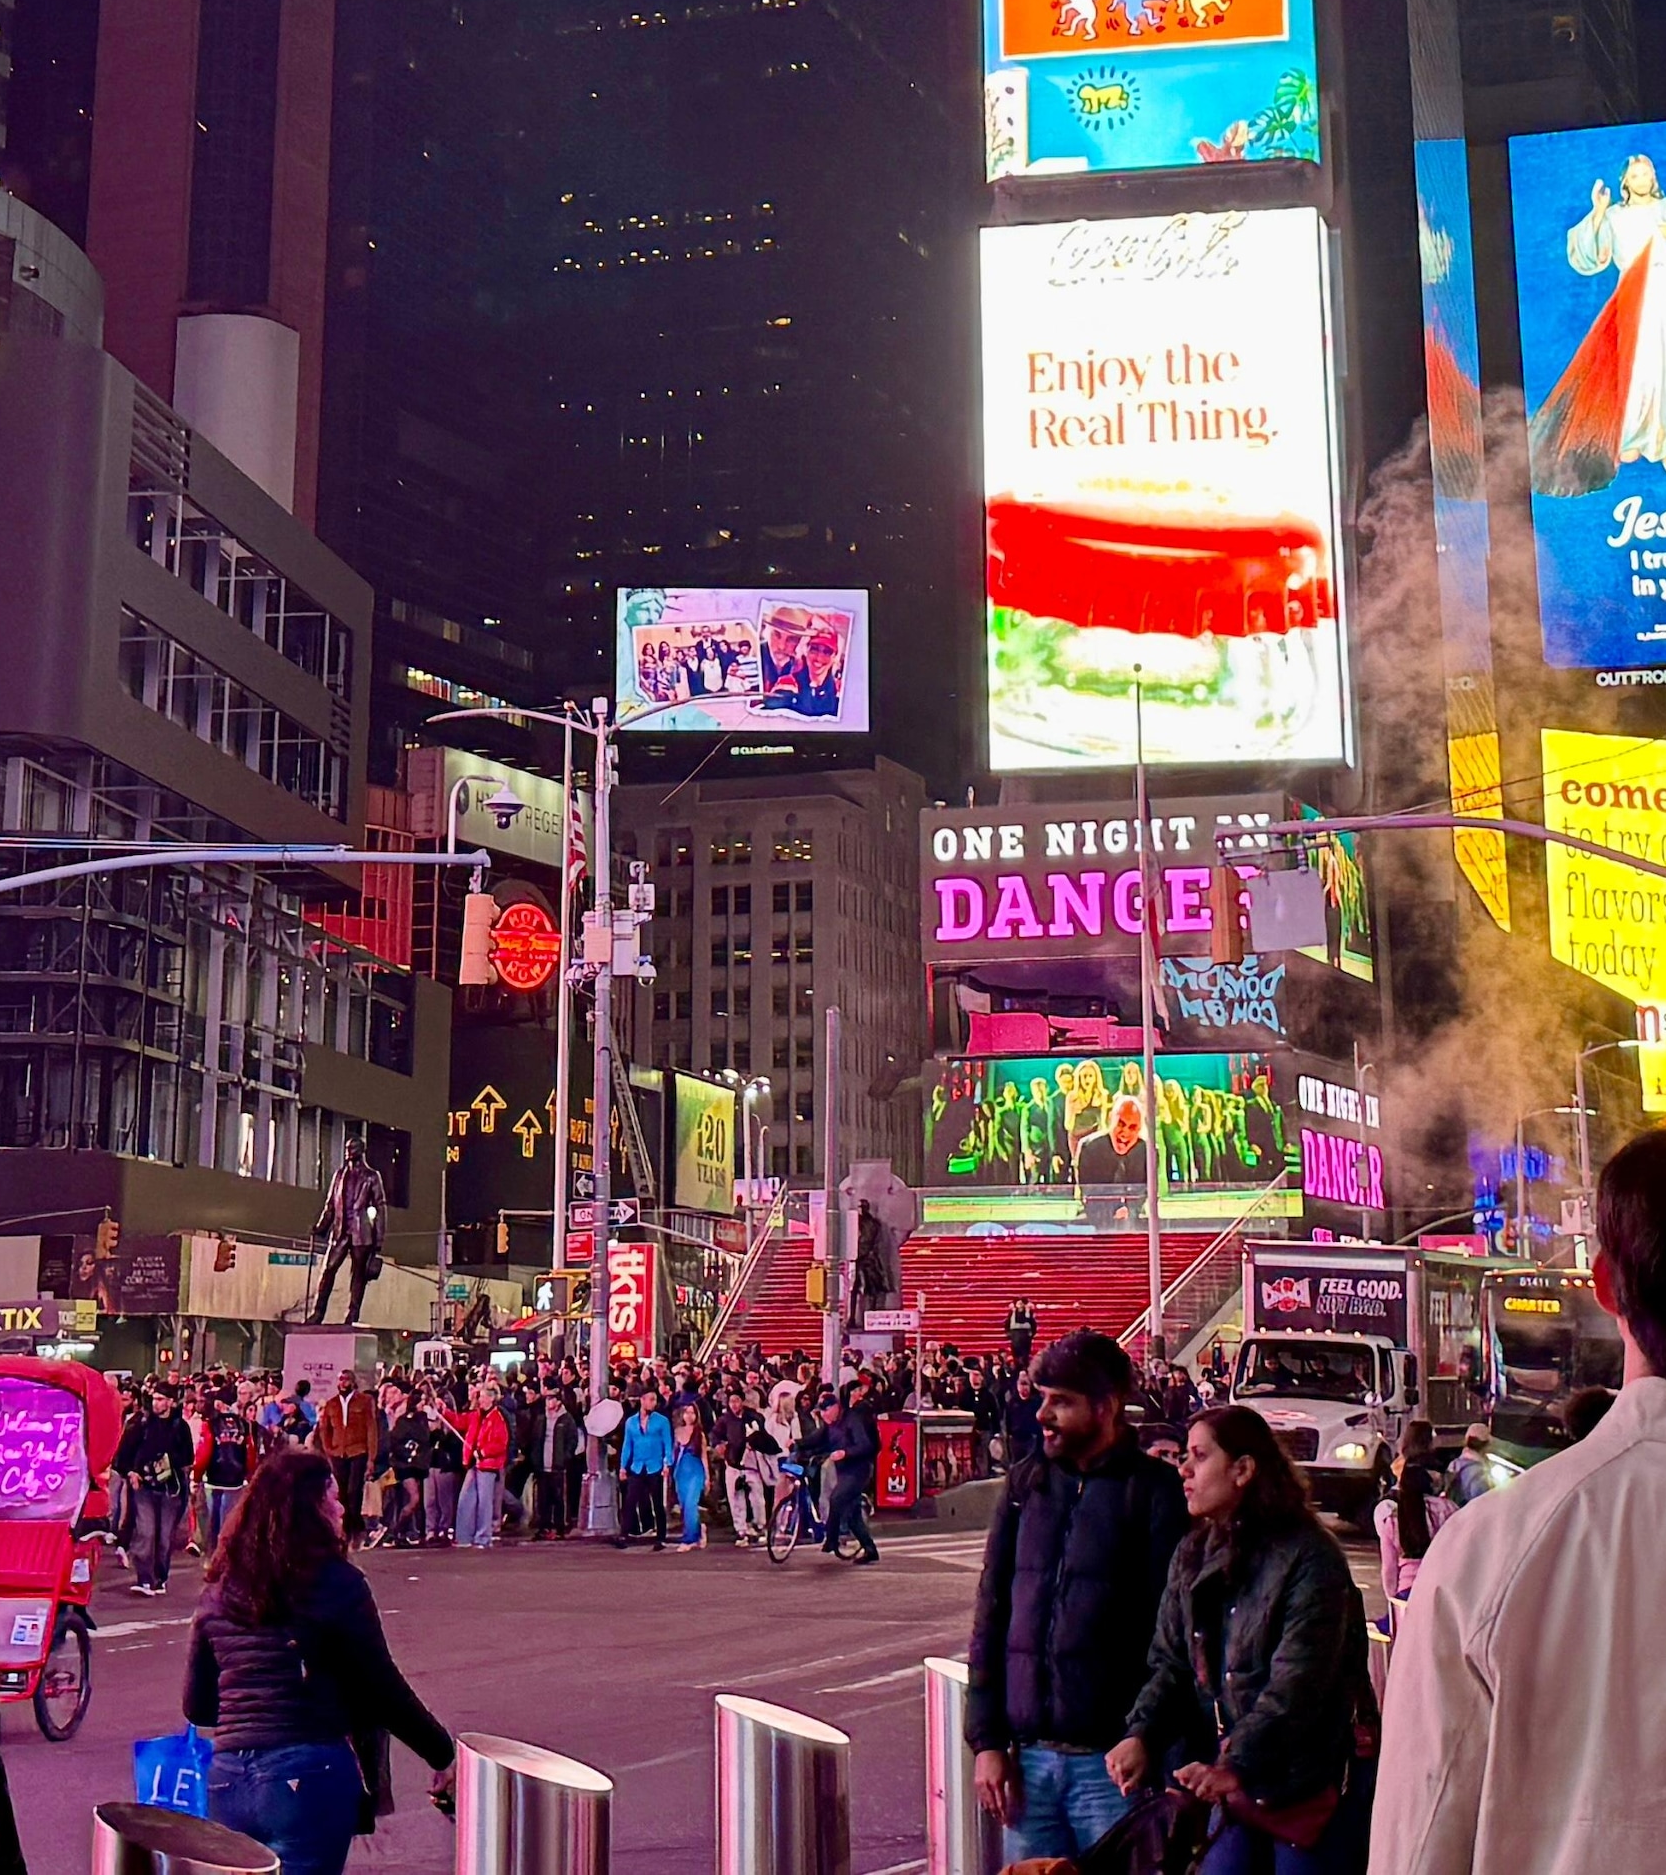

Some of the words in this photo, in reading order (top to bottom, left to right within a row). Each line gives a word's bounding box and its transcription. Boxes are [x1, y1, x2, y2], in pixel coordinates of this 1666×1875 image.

[1028, 349, 1152, 400] Enjoy
[1165, 344, 1239, 386] the
[1030, 399, 1125, 449] Real
[1139, 400, 1279, 447] Thing.
[1630, 550, 1639, 570] I
[933, 825, 1025, 862] ONE
[1602, 823, 1651, 877] try
[1569, 930, 1656, 991] today
[1298, 1075, 1324, 1114] ONE
[697, 1113, 725, 1162] 120
[611, 1249, 644, 1333] tkts
[1319, 1278, 1355, 1295] FEEL
[1357, 1279, 1402, 1300] GOOD.
